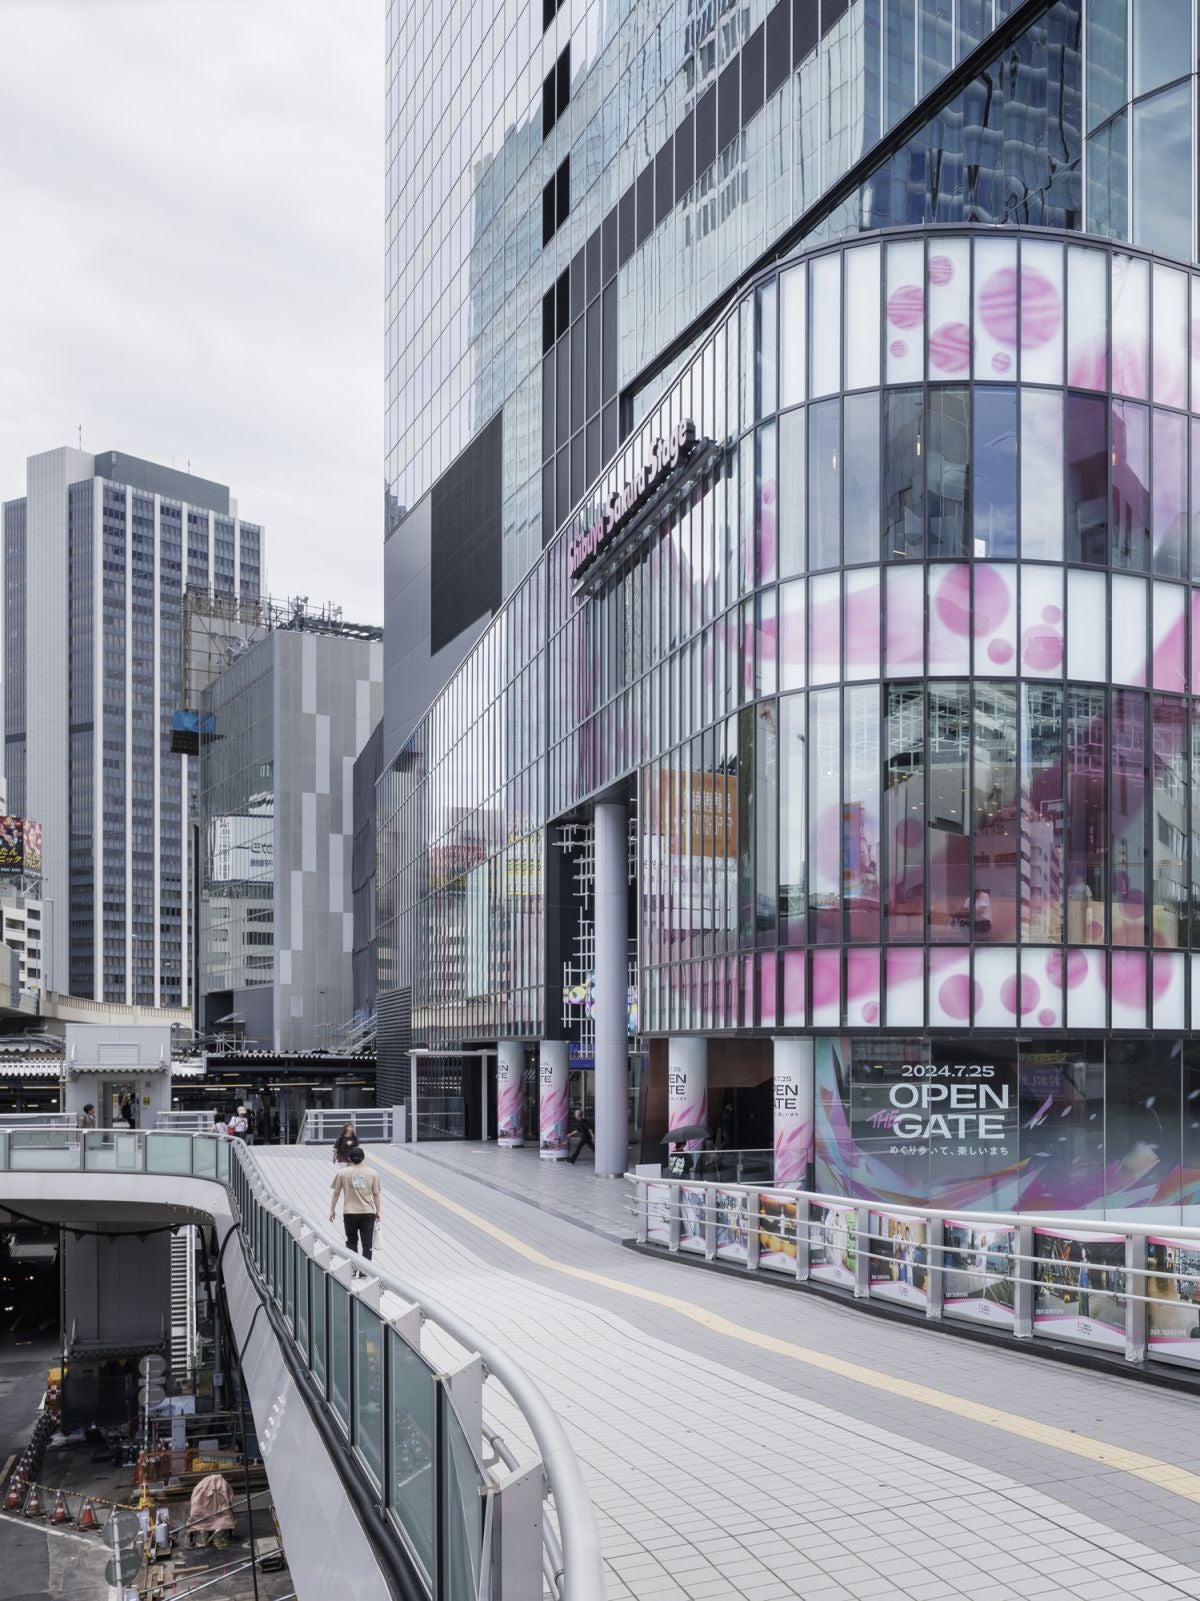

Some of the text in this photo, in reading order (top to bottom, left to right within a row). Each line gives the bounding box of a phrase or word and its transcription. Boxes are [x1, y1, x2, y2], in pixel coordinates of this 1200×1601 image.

[647, 418, 696, 483] Stage
[901, 1065, 995, 1078] 2024.7.25
[889, 1083, 1009, 1109] OPEN
[866, 1109, 1006, 1139] THE GATE
[889, 1145, 1009, 1157] めぐり歩いて、楽しいまち
